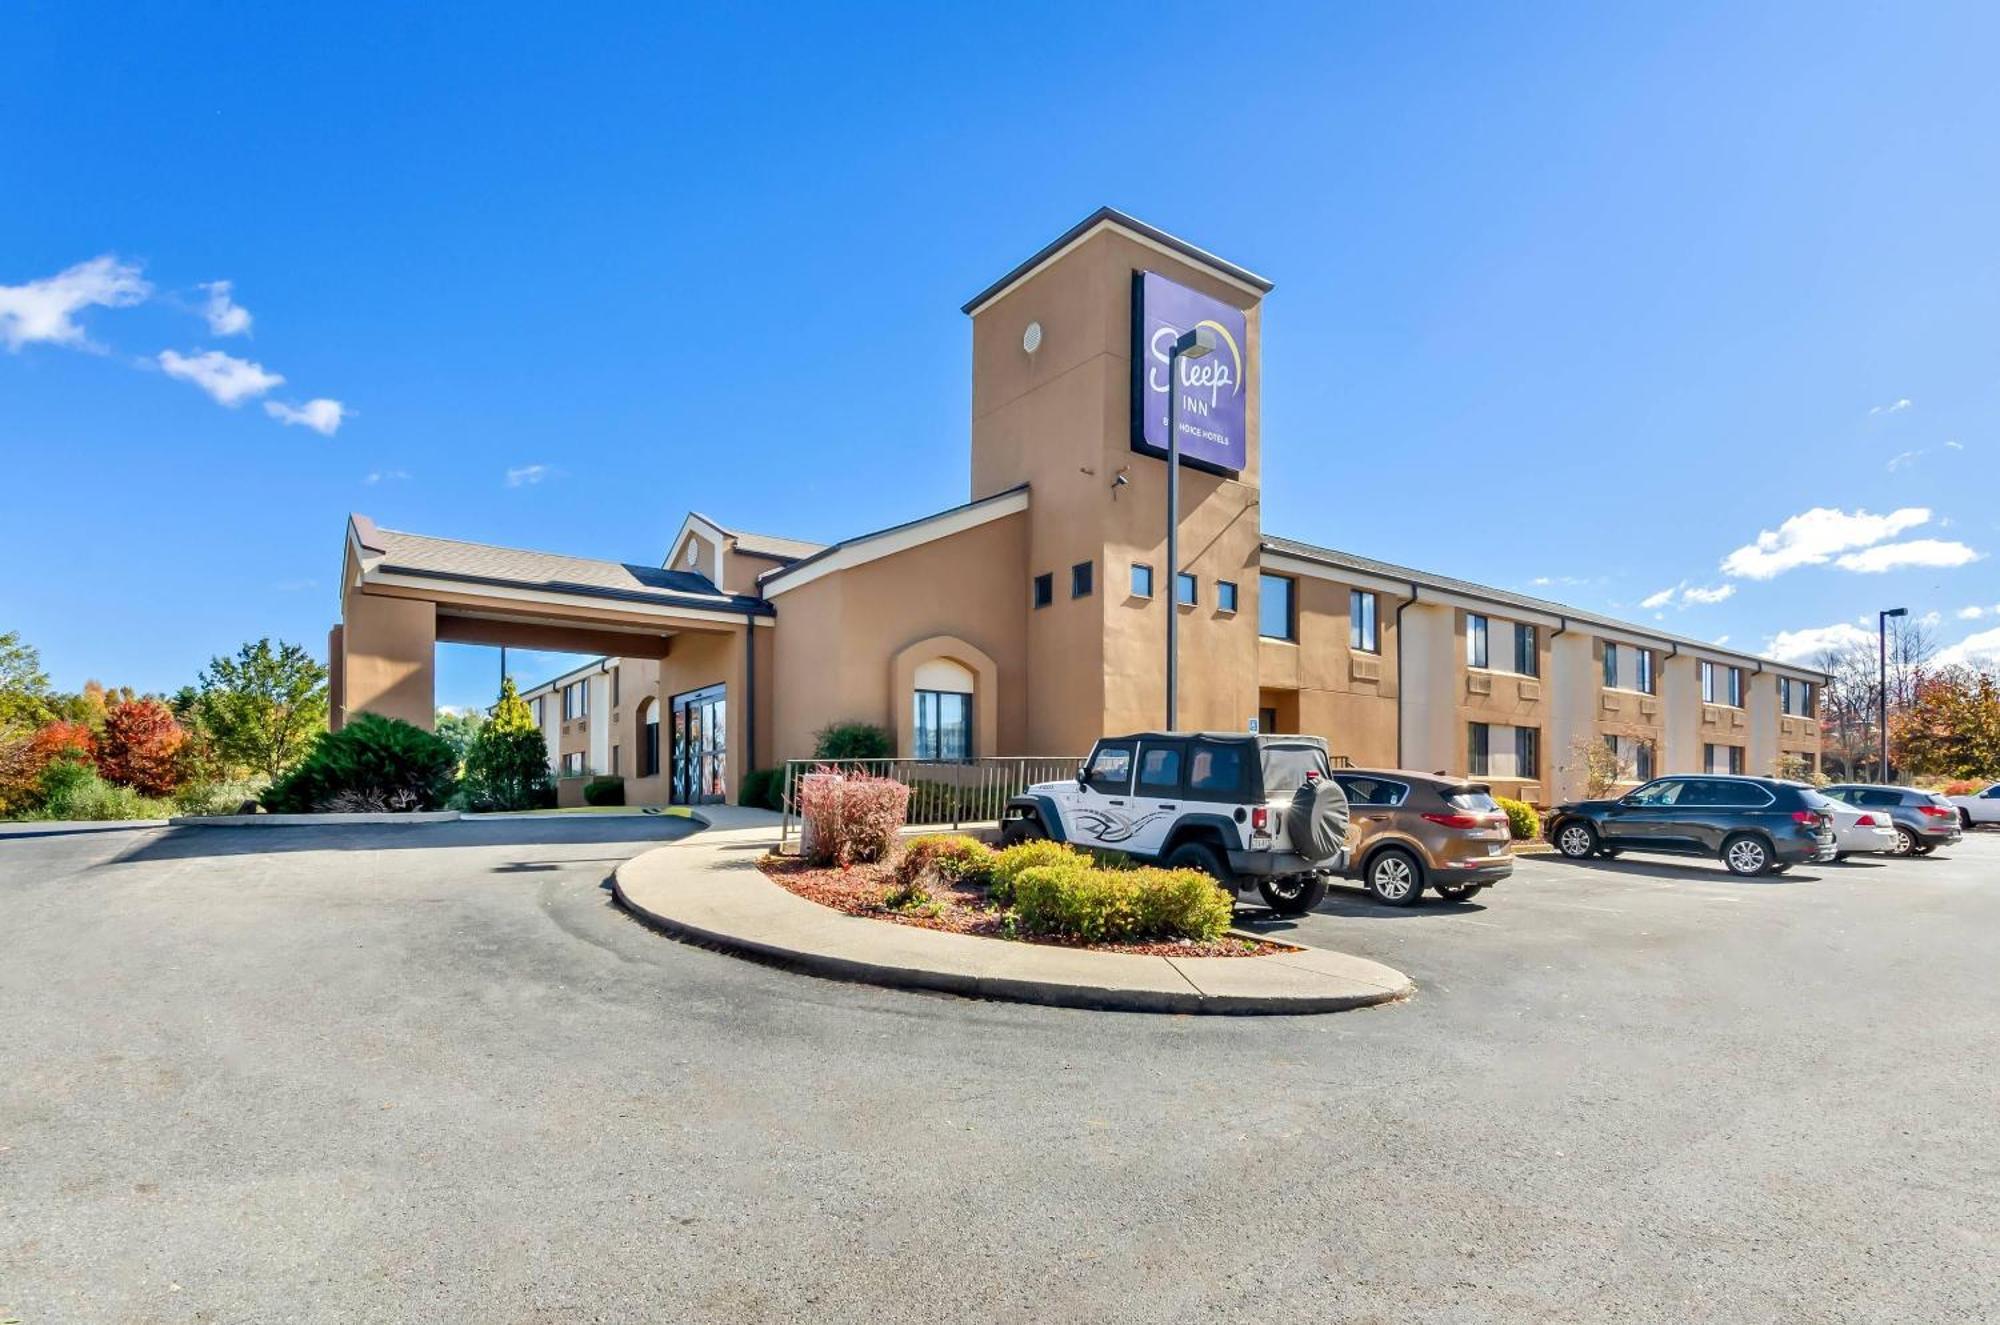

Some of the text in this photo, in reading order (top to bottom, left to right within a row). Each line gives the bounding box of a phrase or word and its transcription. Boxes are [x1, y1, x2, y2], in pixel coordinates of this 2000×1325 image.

[1150, 327, 1232, 408] Sleep
[1183, 395, 1208, 416] INN
[1178, 423, 1202, 437] HOICE
[1202, 430, 1229, 446] HOTELS
